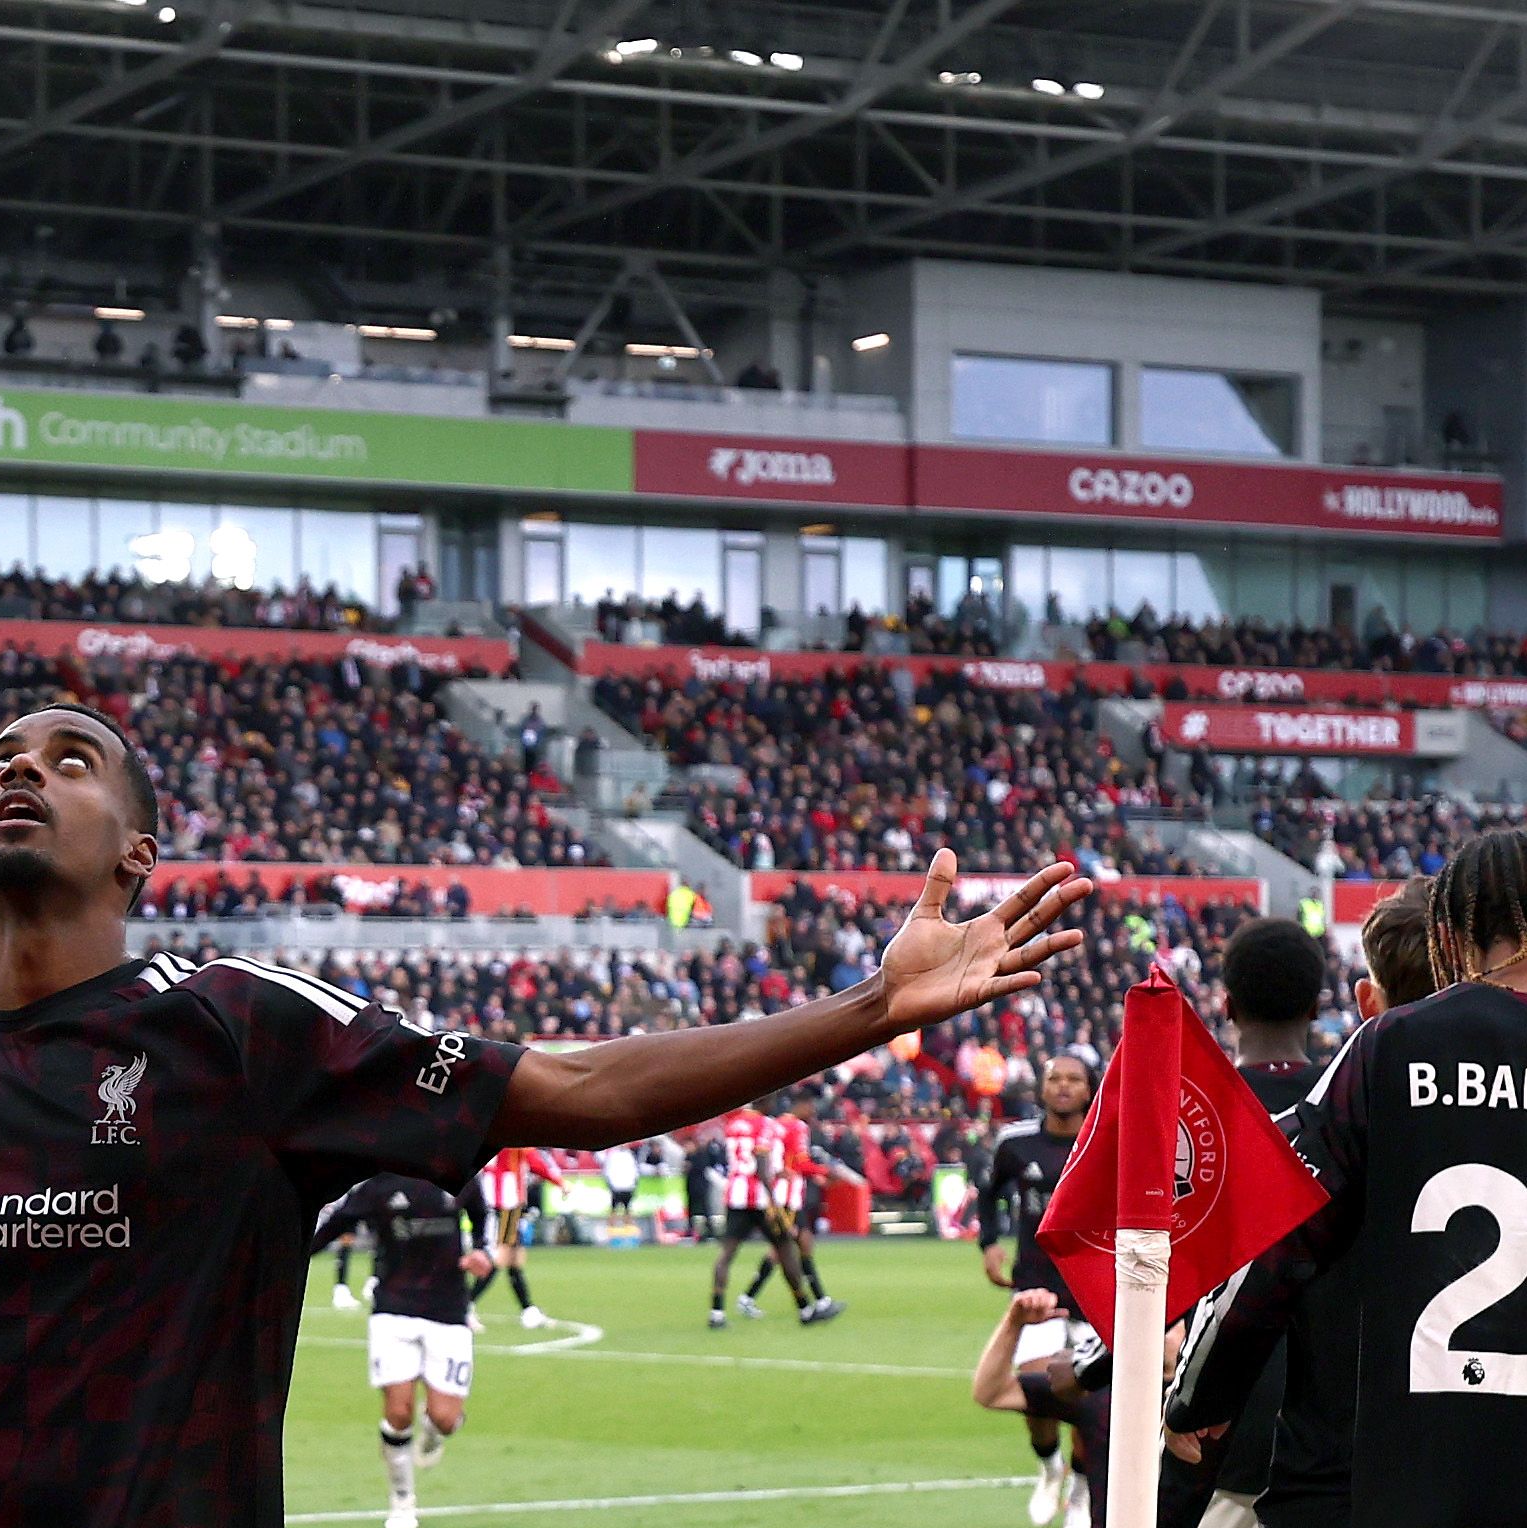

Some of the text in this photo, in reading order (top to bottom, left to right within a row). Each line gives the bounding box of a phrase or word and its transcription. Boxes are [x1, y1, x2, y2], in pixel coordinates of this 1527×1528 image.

[38, 411, 229, 461] Community
[234, 422, 367, 460] Stadium
[415, 1031, 469, 1096] Exp
[444, 1356, 472, 1387] 10
